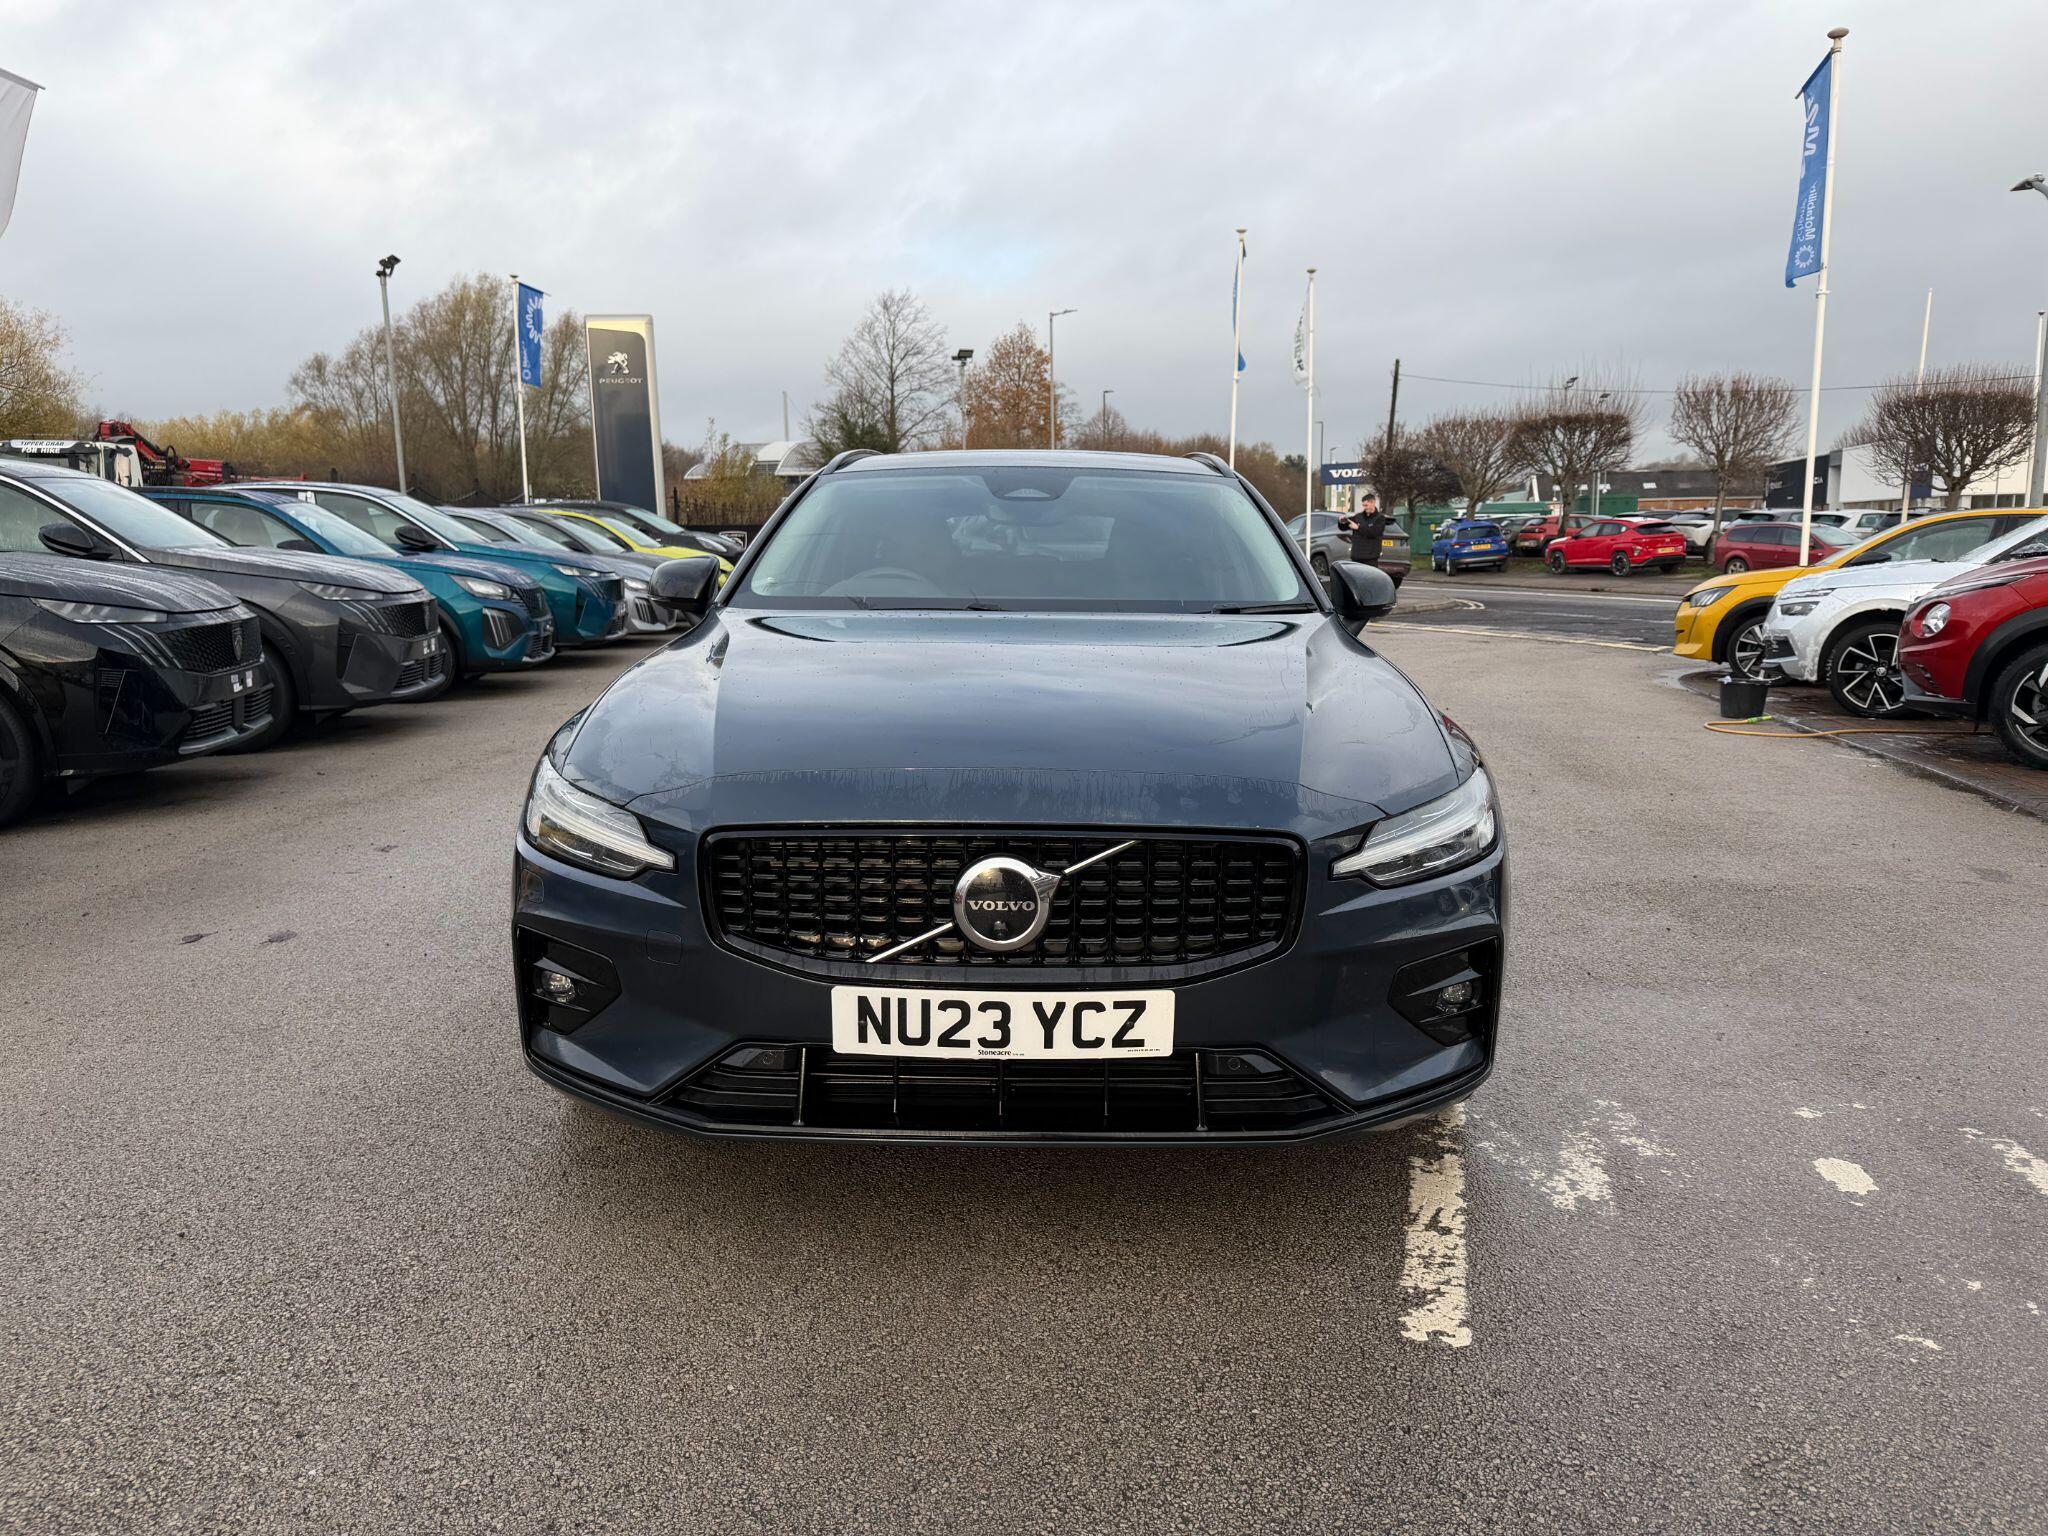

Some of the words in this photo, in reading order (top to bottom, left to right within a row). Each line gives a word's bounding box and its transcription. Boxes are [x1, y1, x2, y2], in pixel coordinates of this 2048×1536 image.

[1329, 468, 1369, 478] VOL
[967, 900, 1036, 912] VOLVO
[857, 995, 1012, 1049] NU23
[1032, 1000, 1147, 1050] YCZ
